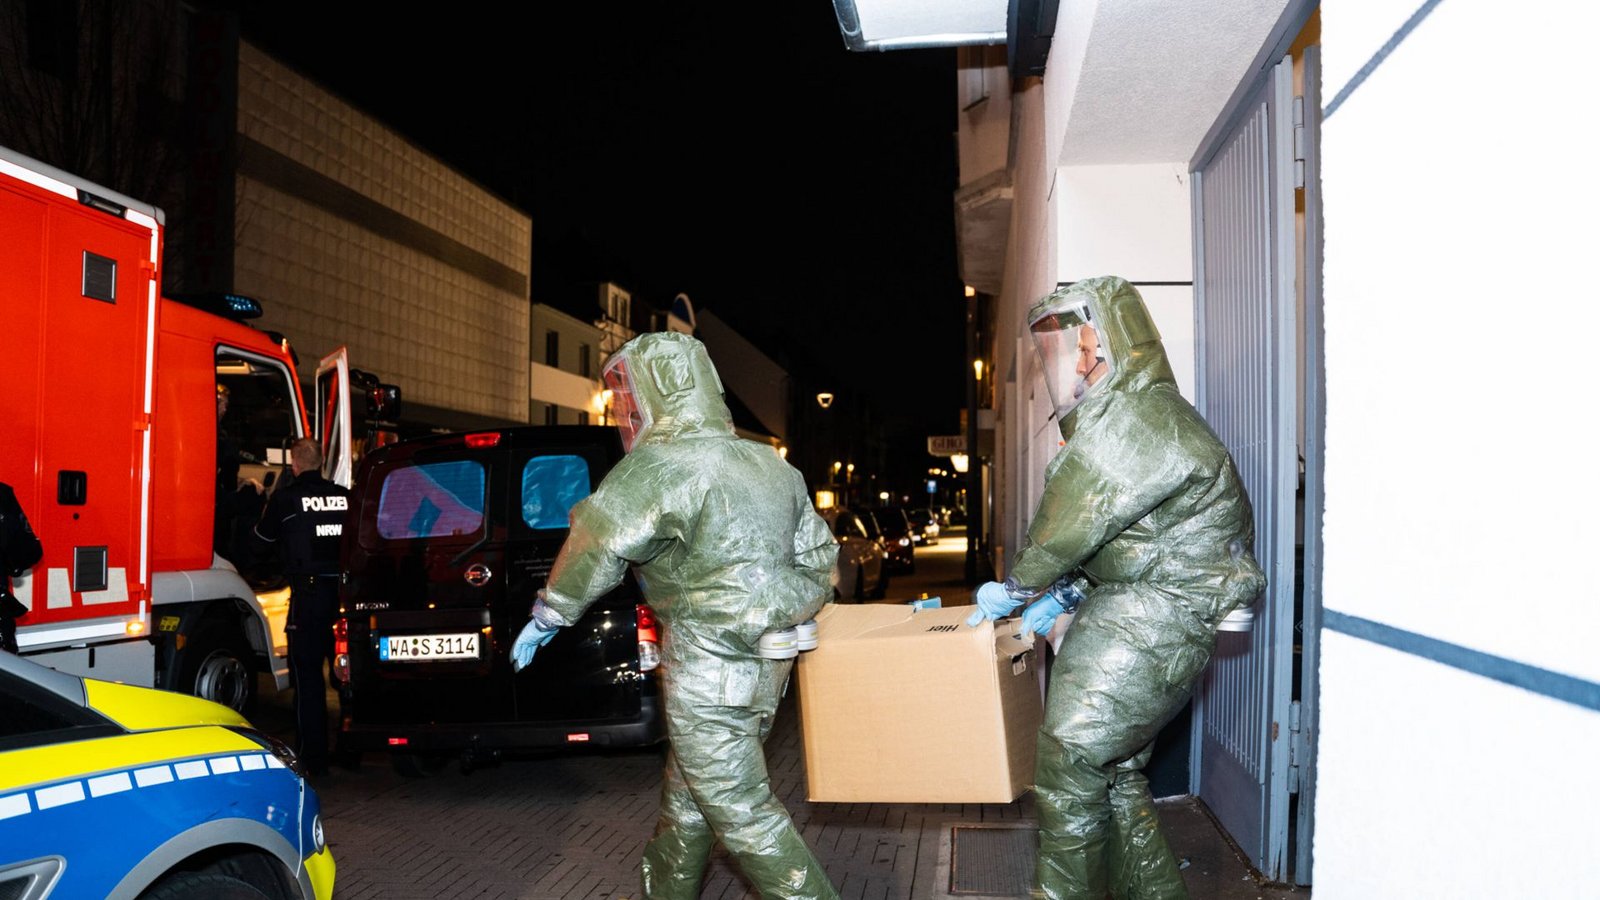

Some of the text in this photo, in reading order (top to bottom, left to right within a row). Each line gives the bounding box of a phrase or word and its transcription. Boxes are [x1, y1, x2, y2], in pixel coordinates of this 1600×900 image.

[302, 496, 348, 511] POLIZEI
[316, 524, 342, 536] NRW
[925, 624, 959, 632] Hier
[390, 637, 475, 656] WA S 3114
